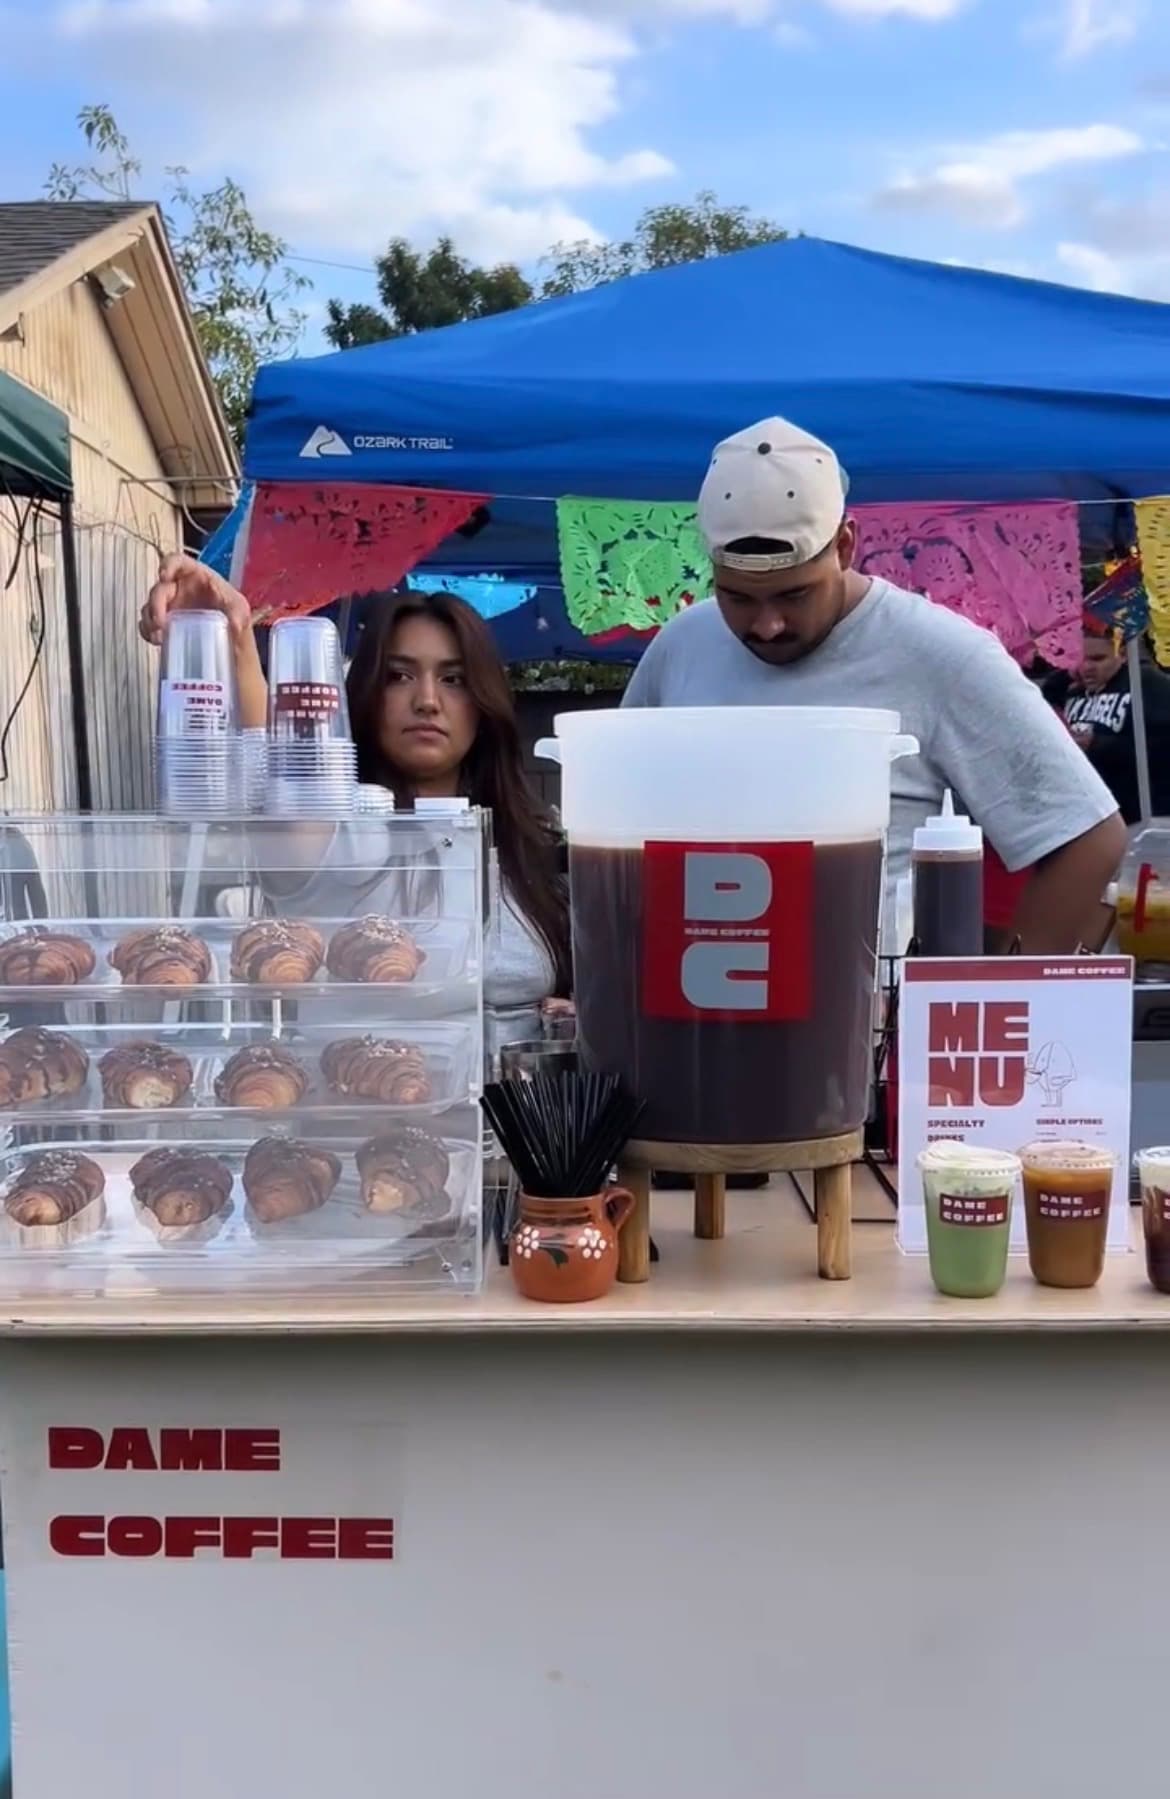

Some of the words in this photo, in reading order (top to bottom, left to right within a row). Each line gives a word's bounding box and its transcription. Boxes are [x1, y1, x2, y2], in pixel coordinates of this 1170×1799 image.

[353, 436, 406, 449] OZARK
[408, 438, 453, 450] TRAIL
[171, 683, 223, 692] COFFEE
[281, 685, 338, 696] COFFEE
[187, 697, 223, 706] DAME
[684, 852, 773, 921] D
[684, 928, 718, 936] DAME
[720, 929, 770, 937] COFFEE
[681, 942, 770, 1010] C
[1043, 967, 1075, 976] DAME
[1077, 967, 1126, 975] COFFEE
[929, 1001, 1029, 1052] ME
[928, 1056, 1025, 1107] NU
[927, 1119, 985, 1128] SPECIALTY
[943, 1197, 986, 1210] DAME
[1039, 1193, 1083, 1206] DAME
[943, 1212, 1004, 1223] COFFEE
[1039, 1207, 1102, 1218] COFFEE
[48, 1427, 280, 1471] DAME
[49, 1515, 394, 1559] COFFEE
